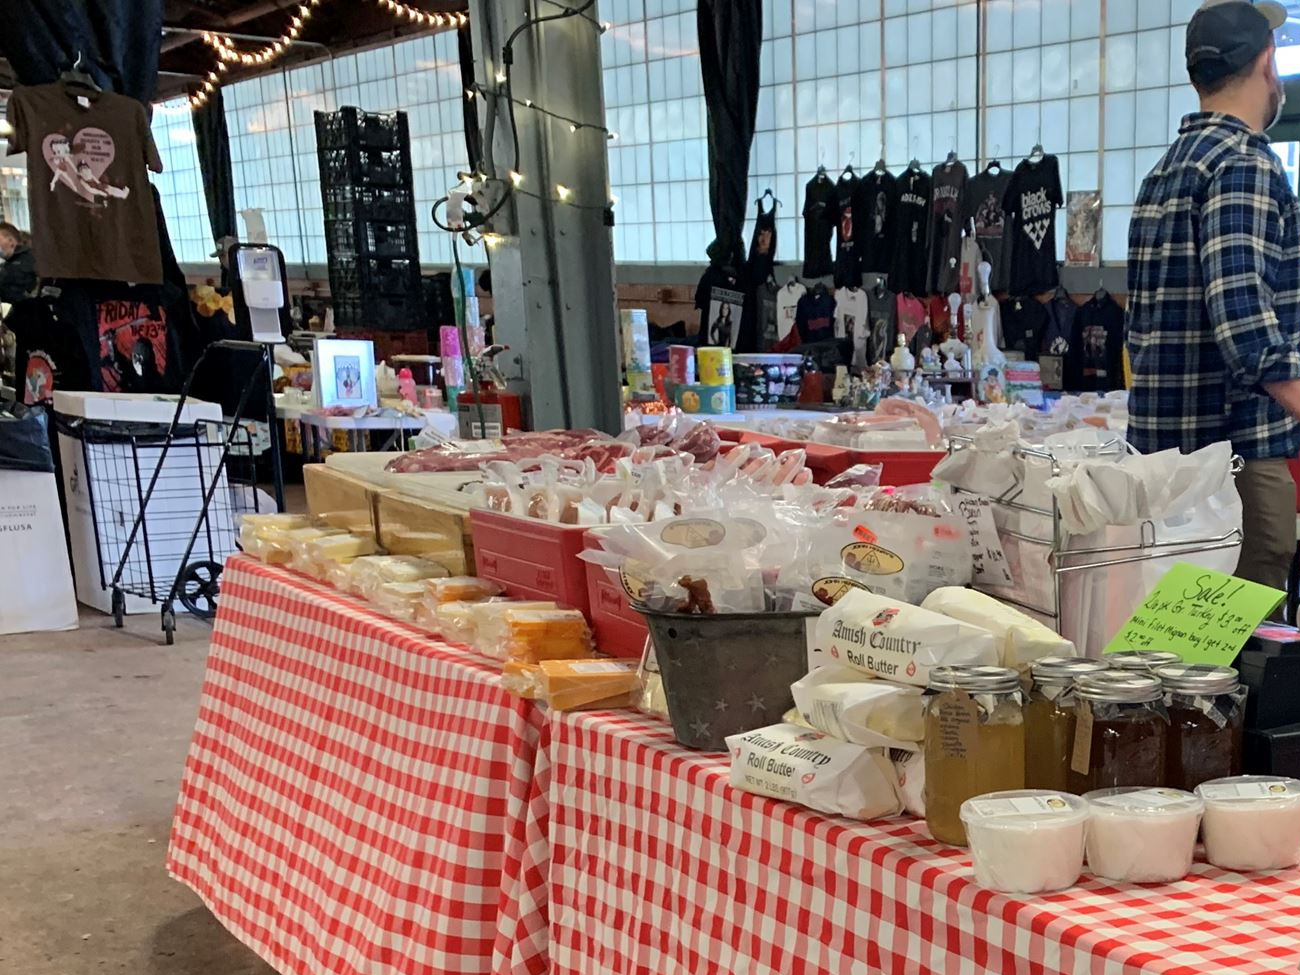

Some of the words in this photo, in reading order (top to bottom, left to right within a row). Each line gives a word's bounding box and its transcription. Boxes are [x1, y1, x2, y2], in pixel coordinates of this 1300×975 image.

[1022, 187, 1047, 208] black
[1022, 200, 1051, 219] crows
[1183, 574, 1245, 607] Sale!
[832, 619, 866, 648] Amish
[870, 631, 921, 656] Country
[1188, 632, 1201, 648] buy
[847, 650, 865, 666] Roll
[868, 655, 899, 676] Butter
[741, 733, 780, 753] Amish
[780, 742, 832, 770] Country
[747, 752, 766, 770] Roll
[766, 758, 796, 778] Butter
